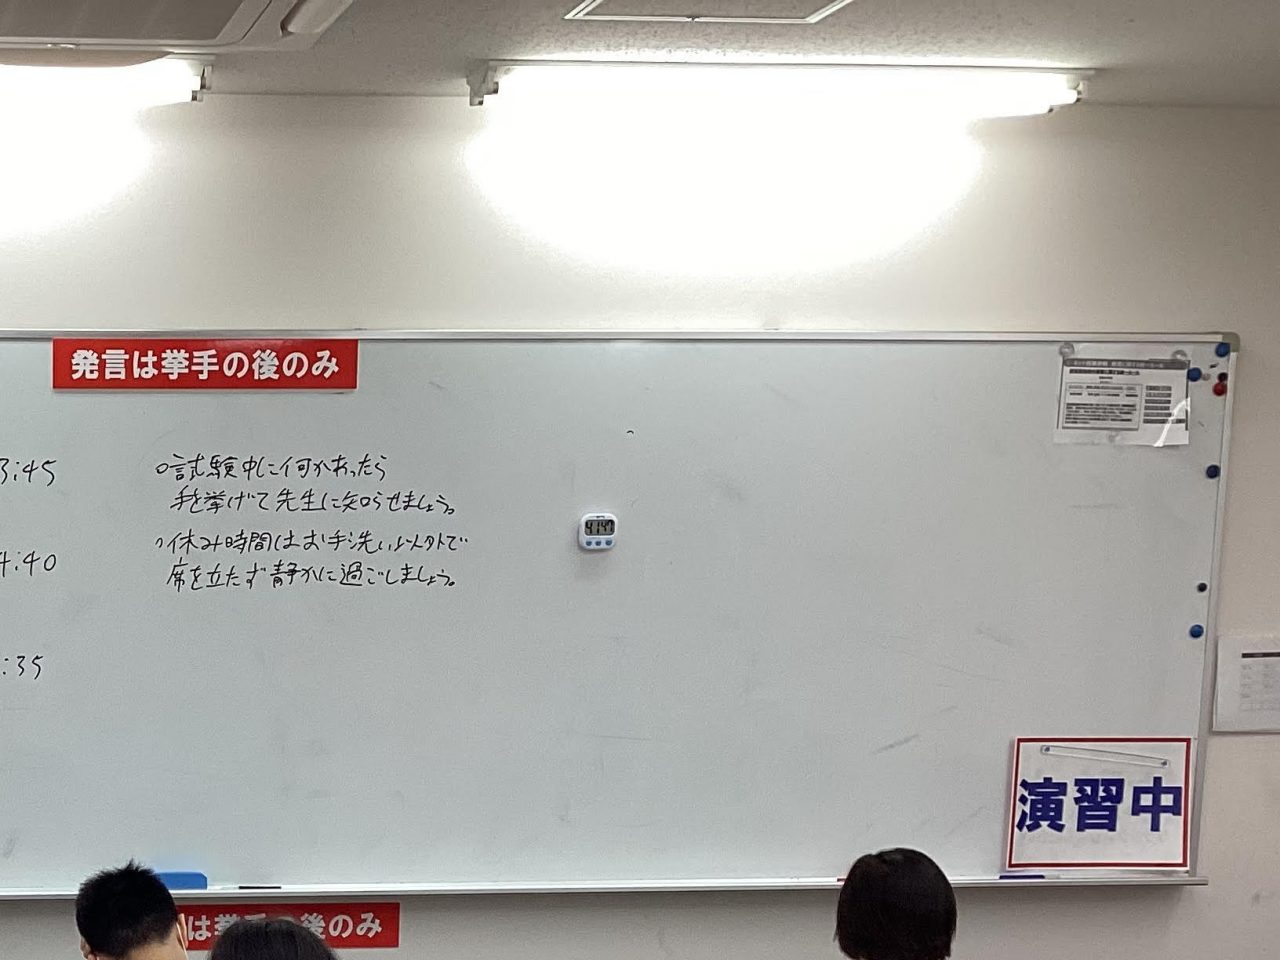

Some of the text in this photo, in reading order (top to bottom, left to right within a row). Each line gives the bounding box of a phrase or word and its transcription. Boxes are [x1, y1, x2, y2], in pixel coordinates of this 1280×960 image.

[70, 348, 340, 381] 発言は挙手の後のみ
[1015, 776, 1183, 833] 演習中
